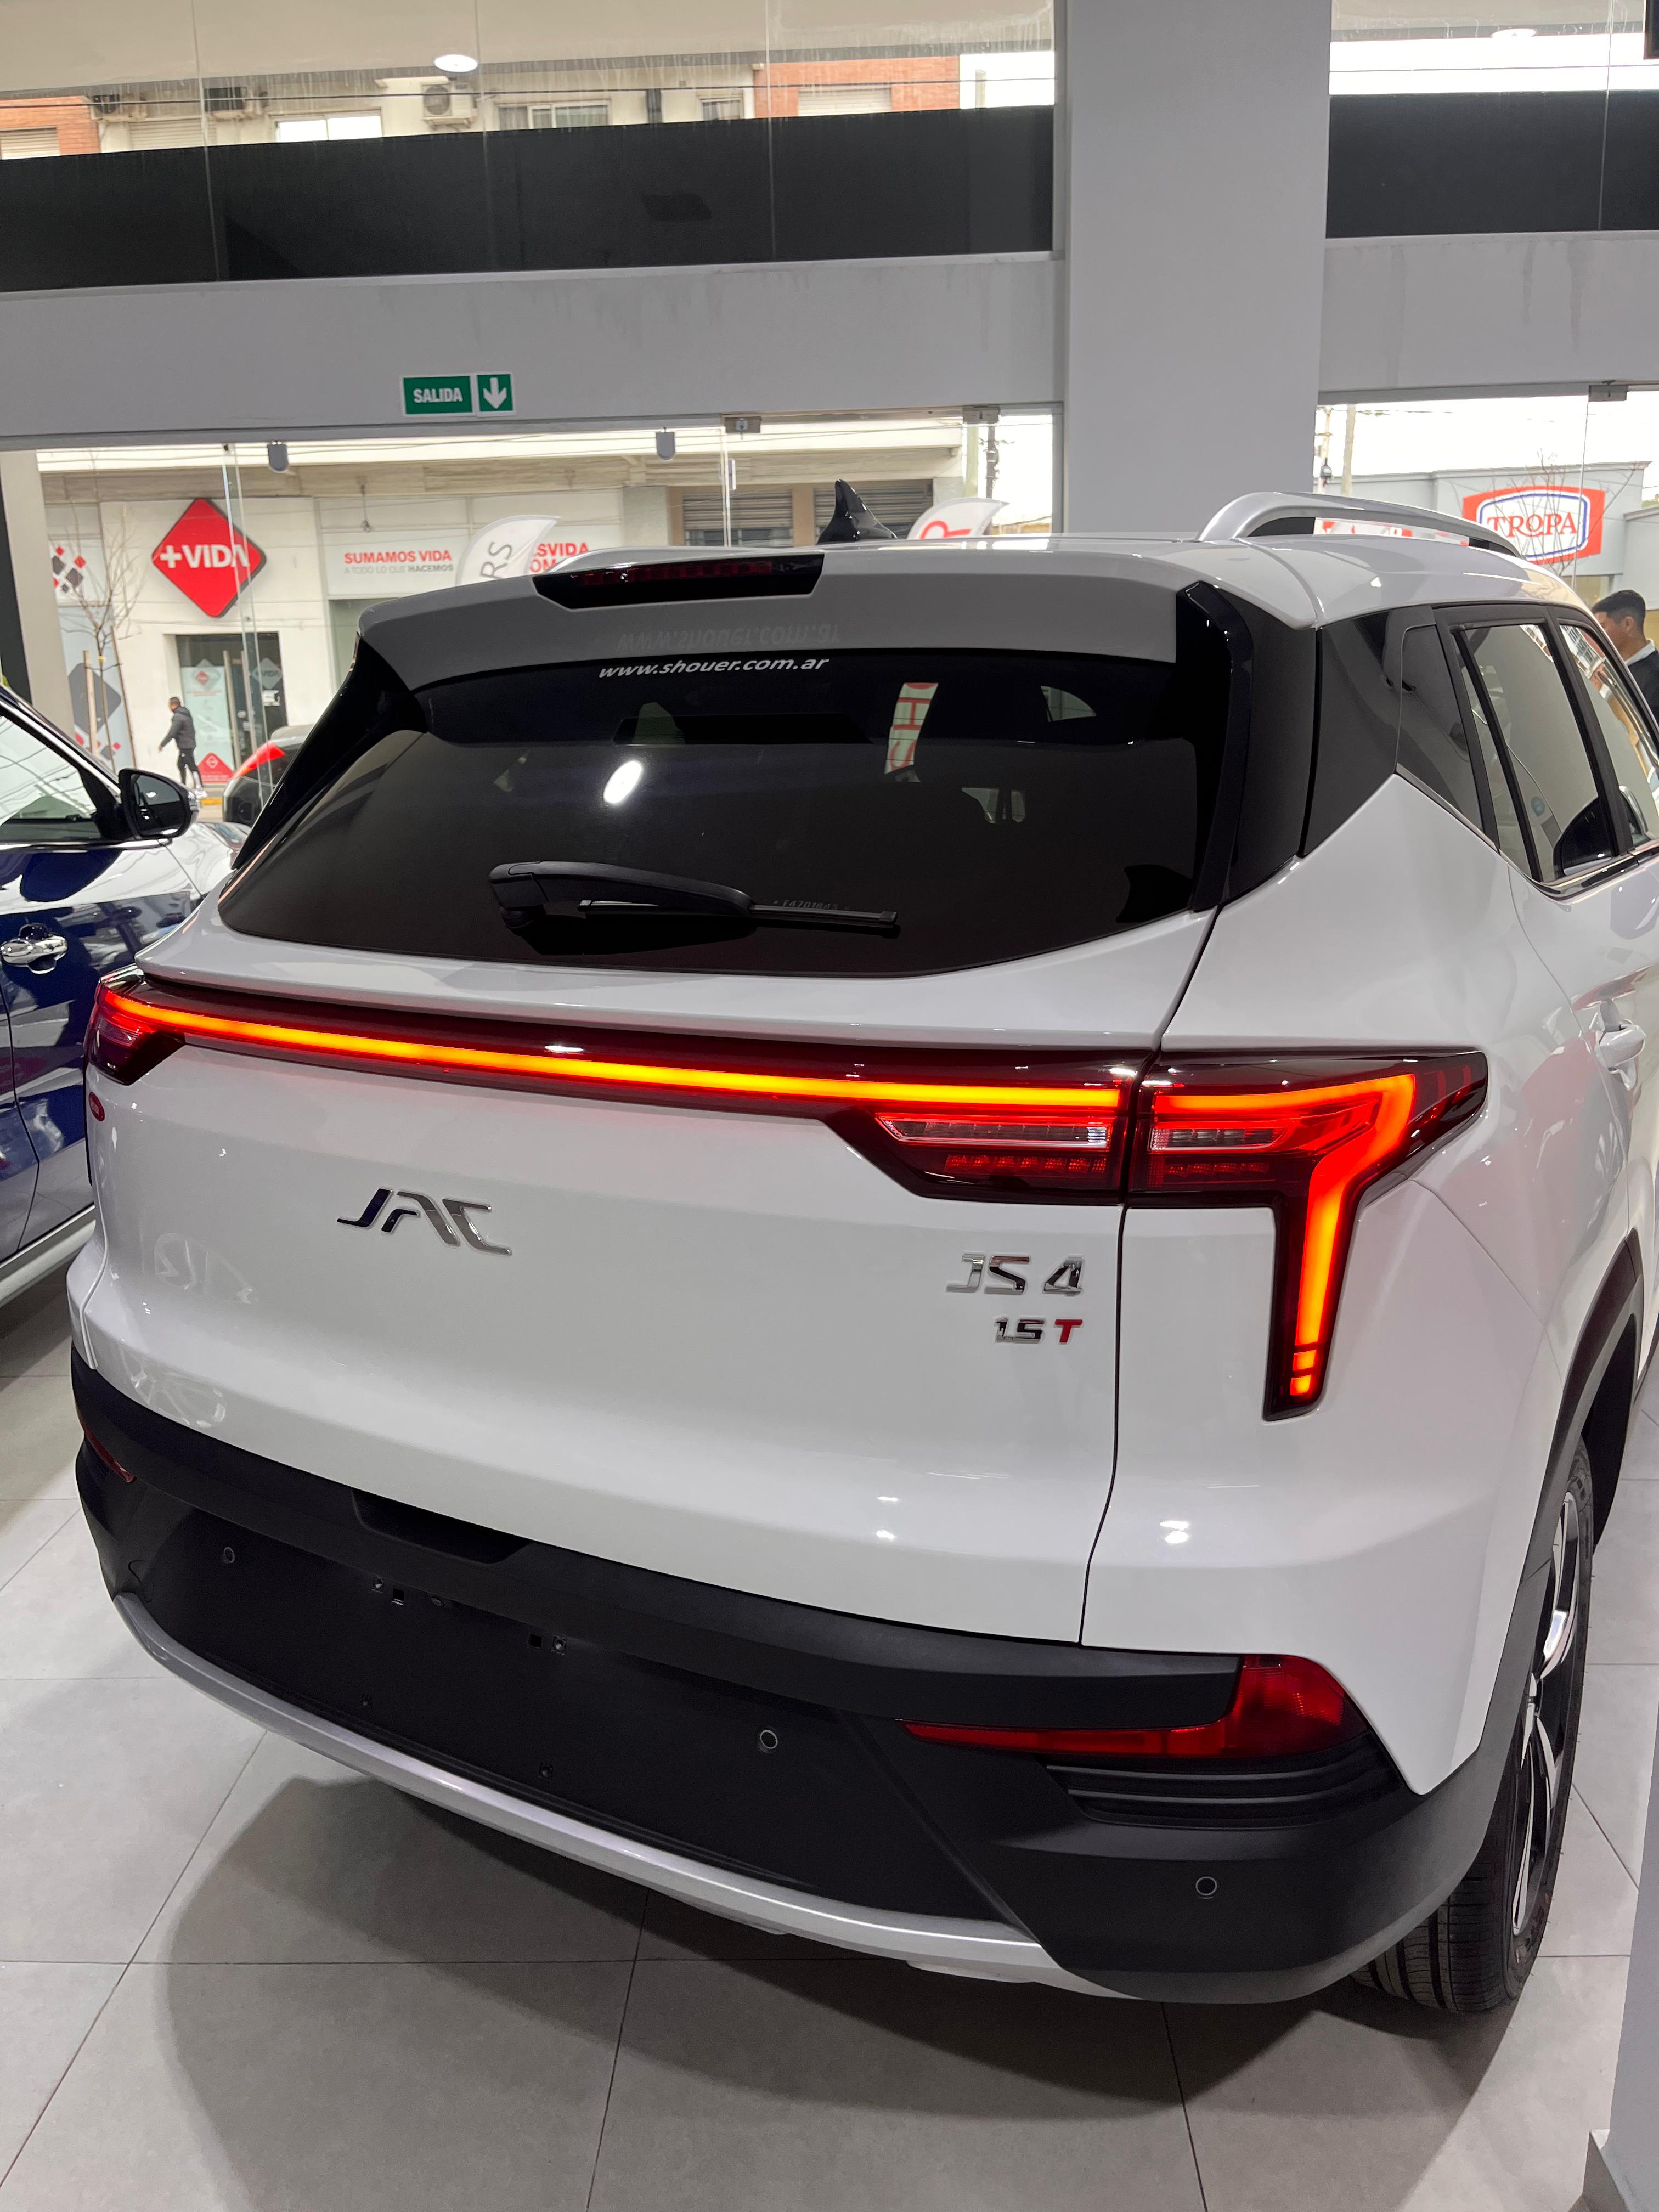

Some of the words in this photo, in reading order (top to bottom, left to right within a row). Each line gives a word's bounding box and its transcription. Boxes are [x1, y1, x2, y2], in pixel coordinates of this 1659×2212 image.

[413, 388, 463, 403] SALIDA
[1487, 512, 1577, 538] TROPA
[344, 551, 416, 564] SUMAMOS
[419, 550, 452, 562] VIDA
[536, 543, 589, 557] SVIDA
[408, 564, 454, 573] HACEMOS
[480, 542, 512, 579] RS
[599, 658, 830, 678] www.shouer.com.ar
[336, 1187, 513, 1256] JAC
